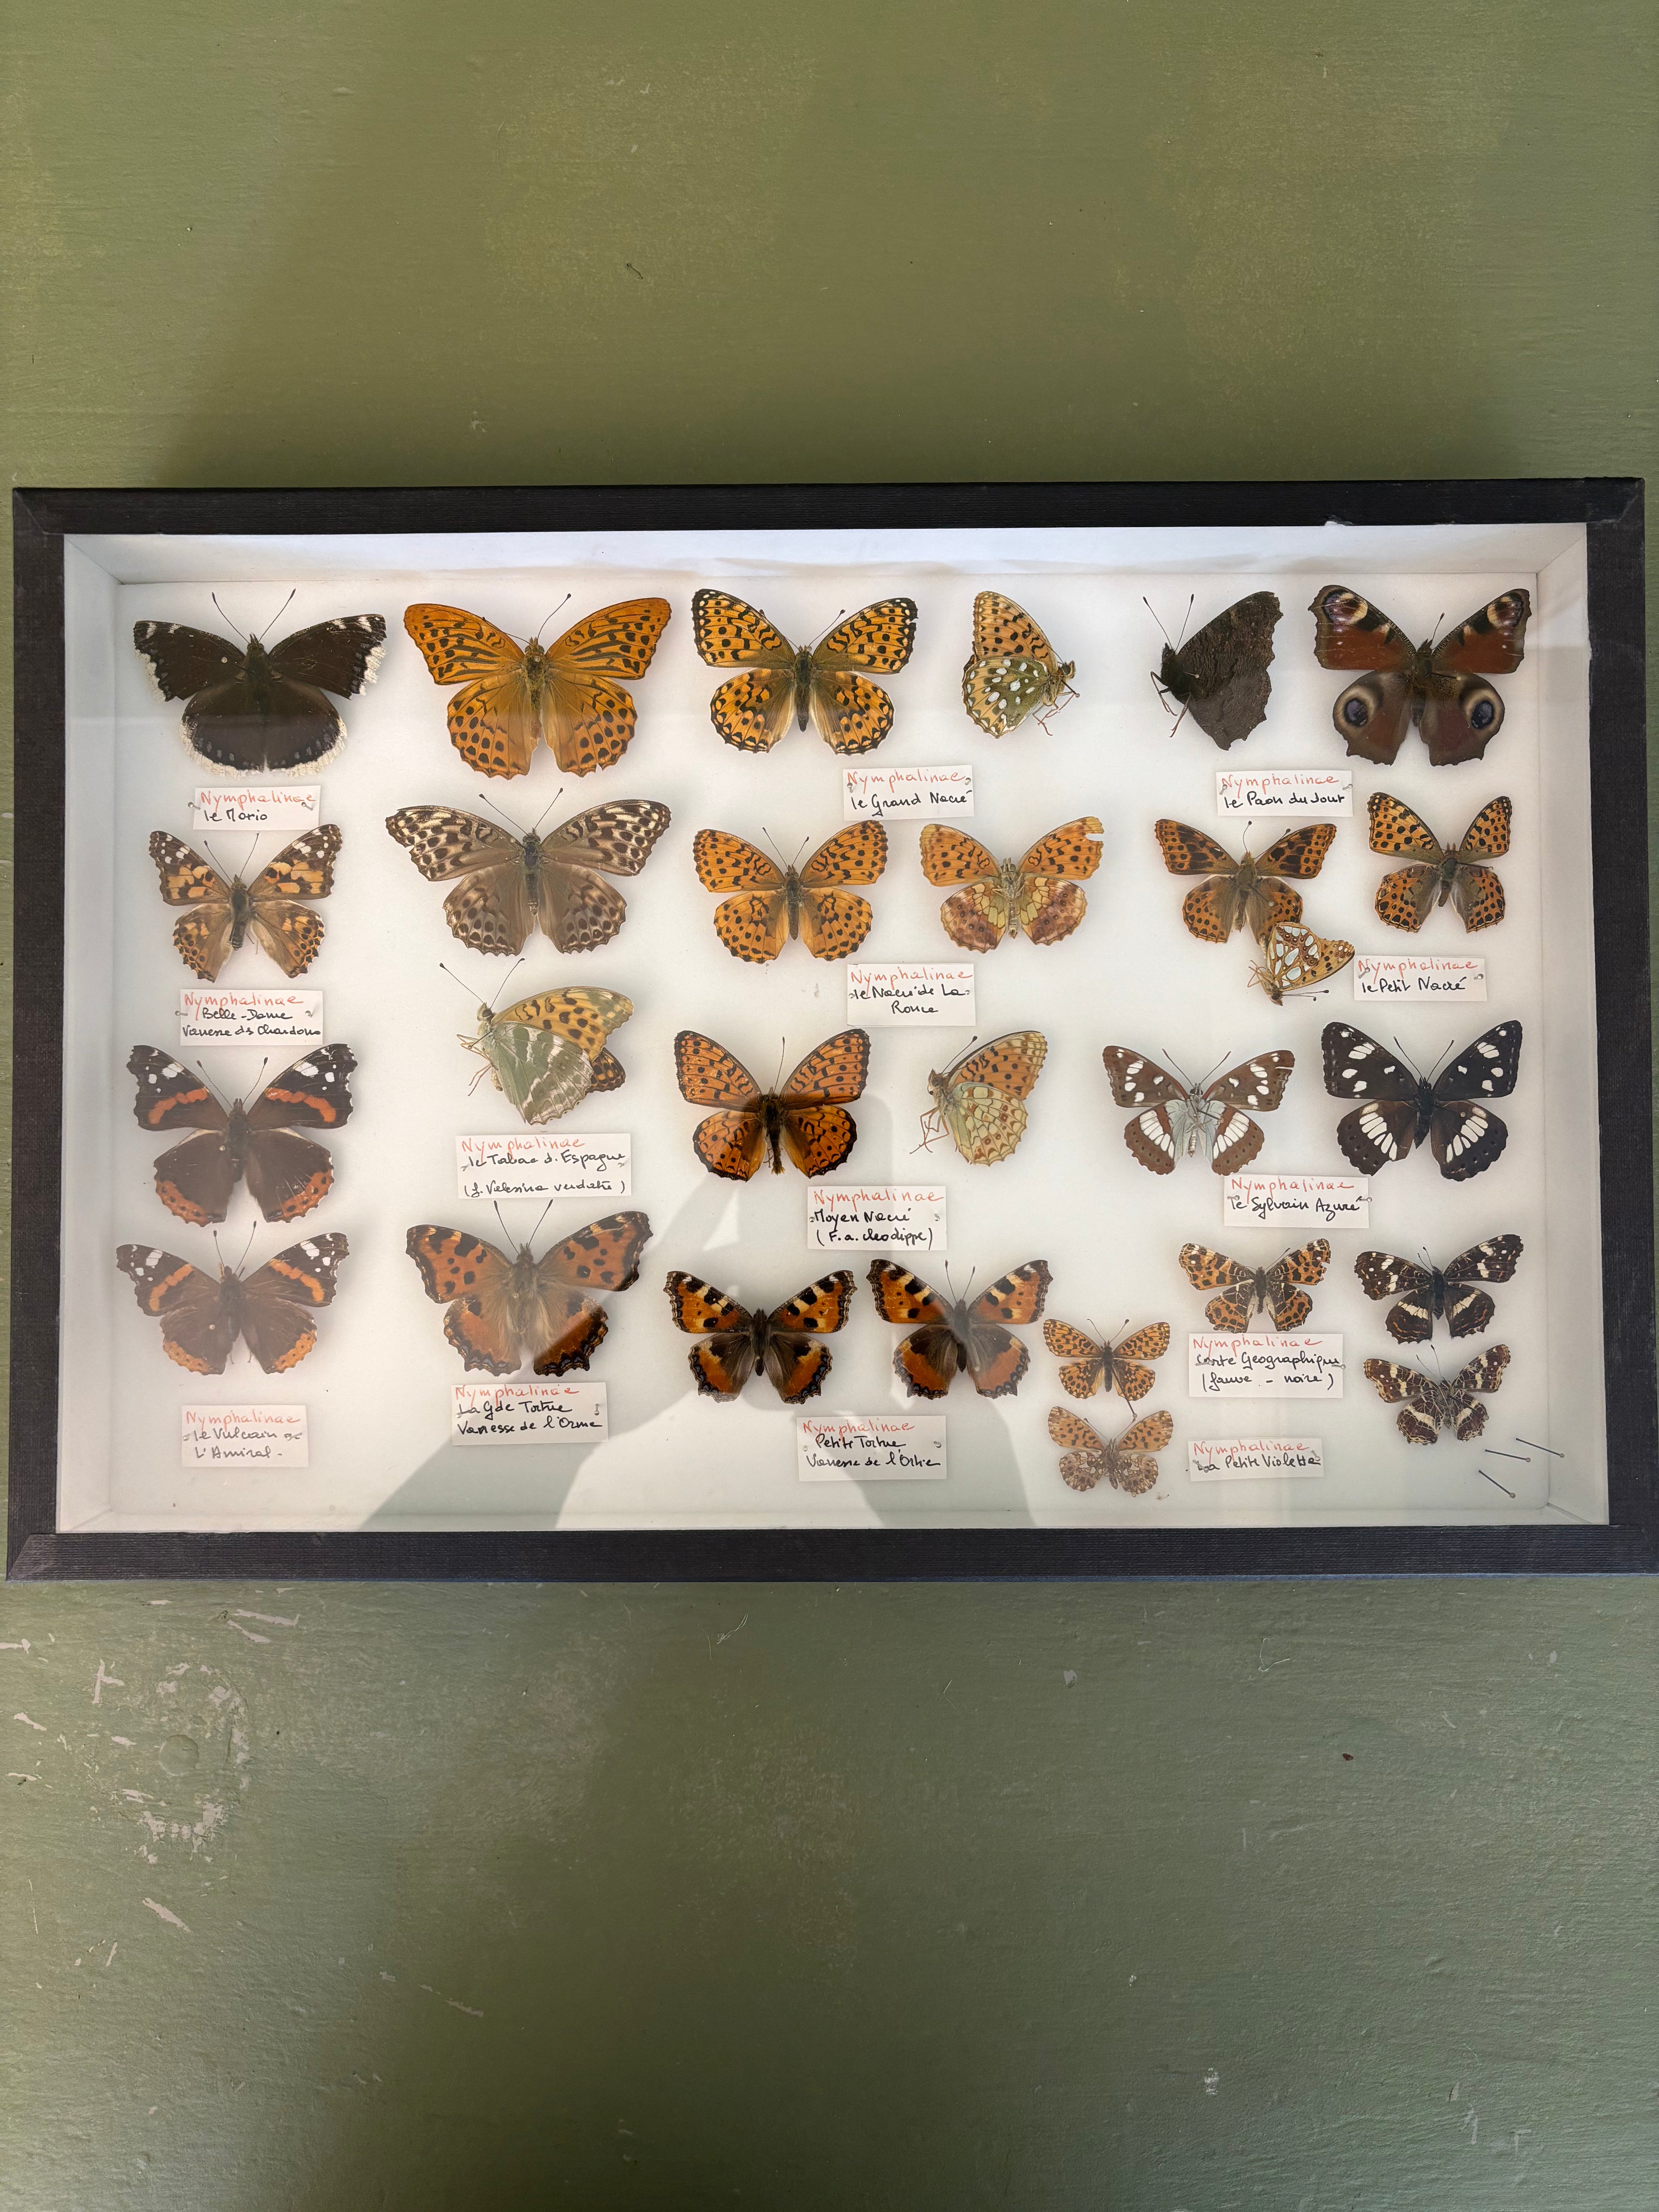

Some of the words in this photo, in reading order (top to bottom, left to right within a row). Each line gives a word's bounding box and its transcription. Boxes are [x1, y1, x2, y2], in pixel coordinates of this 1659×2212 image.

[848, 769, 966, 794] Nymphalinae
[1222, 774, 1339, 799] Nymphalinae
[201, 789, 316, 812] Nymphalinae
[852, 797, 867, 809] le
[871, 793, 921, 817] Grand
[1224, 797, 1243, 808] le
[1247, 791, 1283, 805] Paon
[1289, 792, 1308, 804] du
[1310, 792, 1345, 803] Jour
[204, 809, 222, 821] le
[226, 808, 268, 822] Morio
[851, 966, 973, 996] Nymphalinae
[1358, 958, 1478, 984] Nymphalinae
[854, 989, 871, 1000] le
[1362, 982, 1378, 993] le
[1379, 978, 1411, 993] Petit
[184, 992, 303, 1021] Nymphalinae
[891, 1000, 939, 1014] Ronce
[462, 1136, 585, 1166] Nymphalinae
[469, 1156, 487, 1167] le
[487, 1152, 538, 1164] Tabac
[814, 1188, 945, 1212] Nymphalinae
[1232, 1176, 1354, 1204] Nymphalinae
[814, 1208, 859, 1231] Moyen
[1252, 1197, 1309, 1219] Sylvain
[1194, 1334, 1322, 1357] Nymphalinae
[455, 1384, 579, 1408] Nymphalinae
[186, 1409, 301, 1432] Nymphalinae
[457, 1421, 515, 1435] Vanesse
[520, 1421, 537, 1429] de
[803, 1418, 915, 1443] Nymphalinae
[194, 1431, 211, 1441] le
[213, 1426, 277, 1439] Vulcain
[865, 1457, 881, 1466] de
[1194, 1439, 1309, 1465] Nymphalinae
